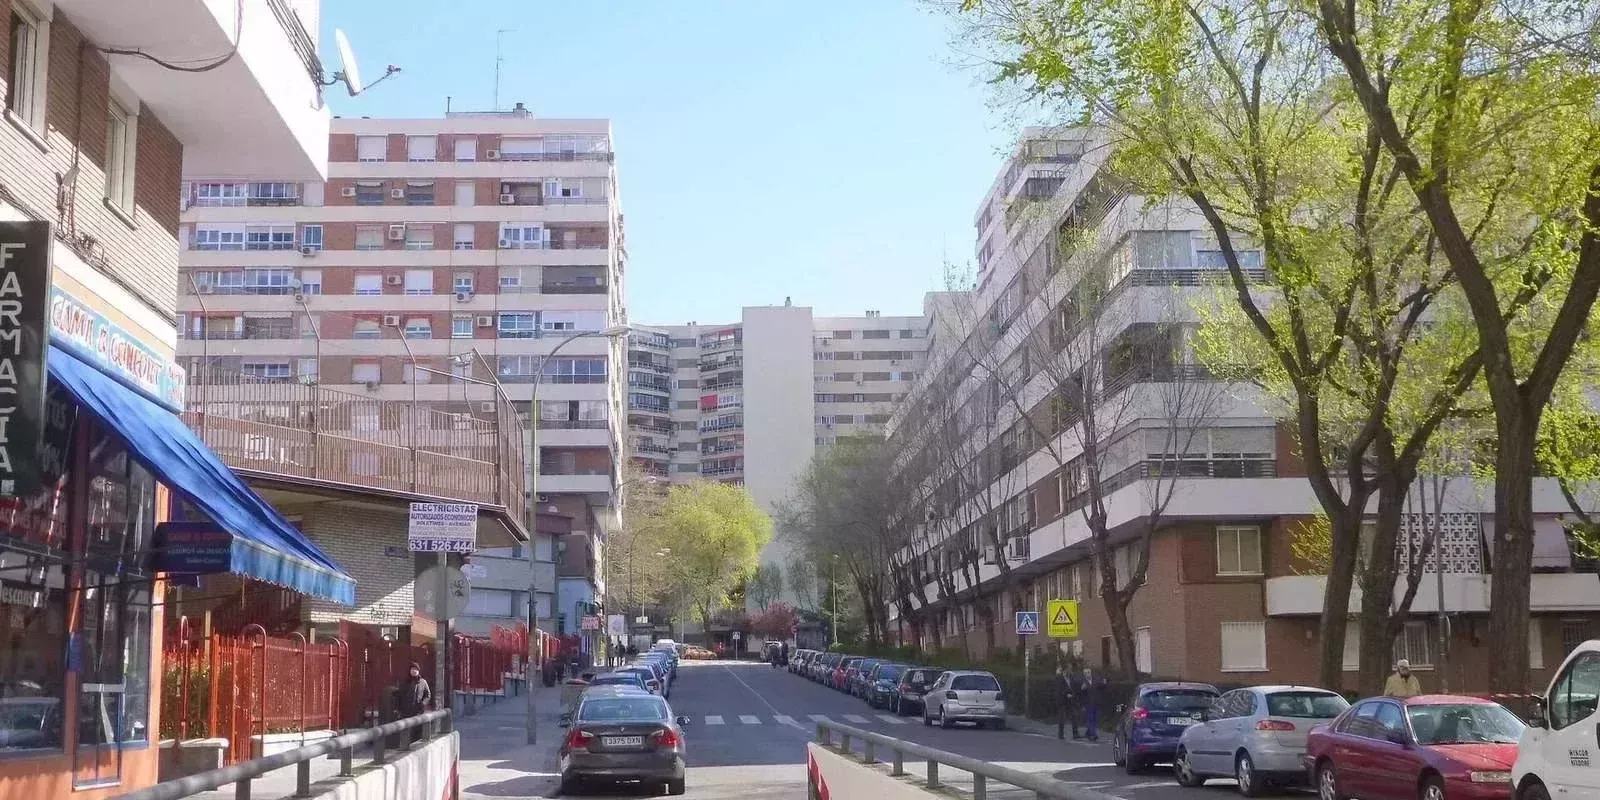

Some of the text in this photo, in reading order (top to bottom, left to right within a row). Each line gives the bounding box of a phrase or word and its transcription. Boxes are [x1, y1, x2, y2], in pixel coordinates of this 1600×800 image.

[0, 243, 26, 472] FARMACIA
[412, 503, 476, 513] ELECTRICISTAS
[410, 513, 443, 521] AUTORIZADOS
[410, 540, 474, 552] 631 526 444
